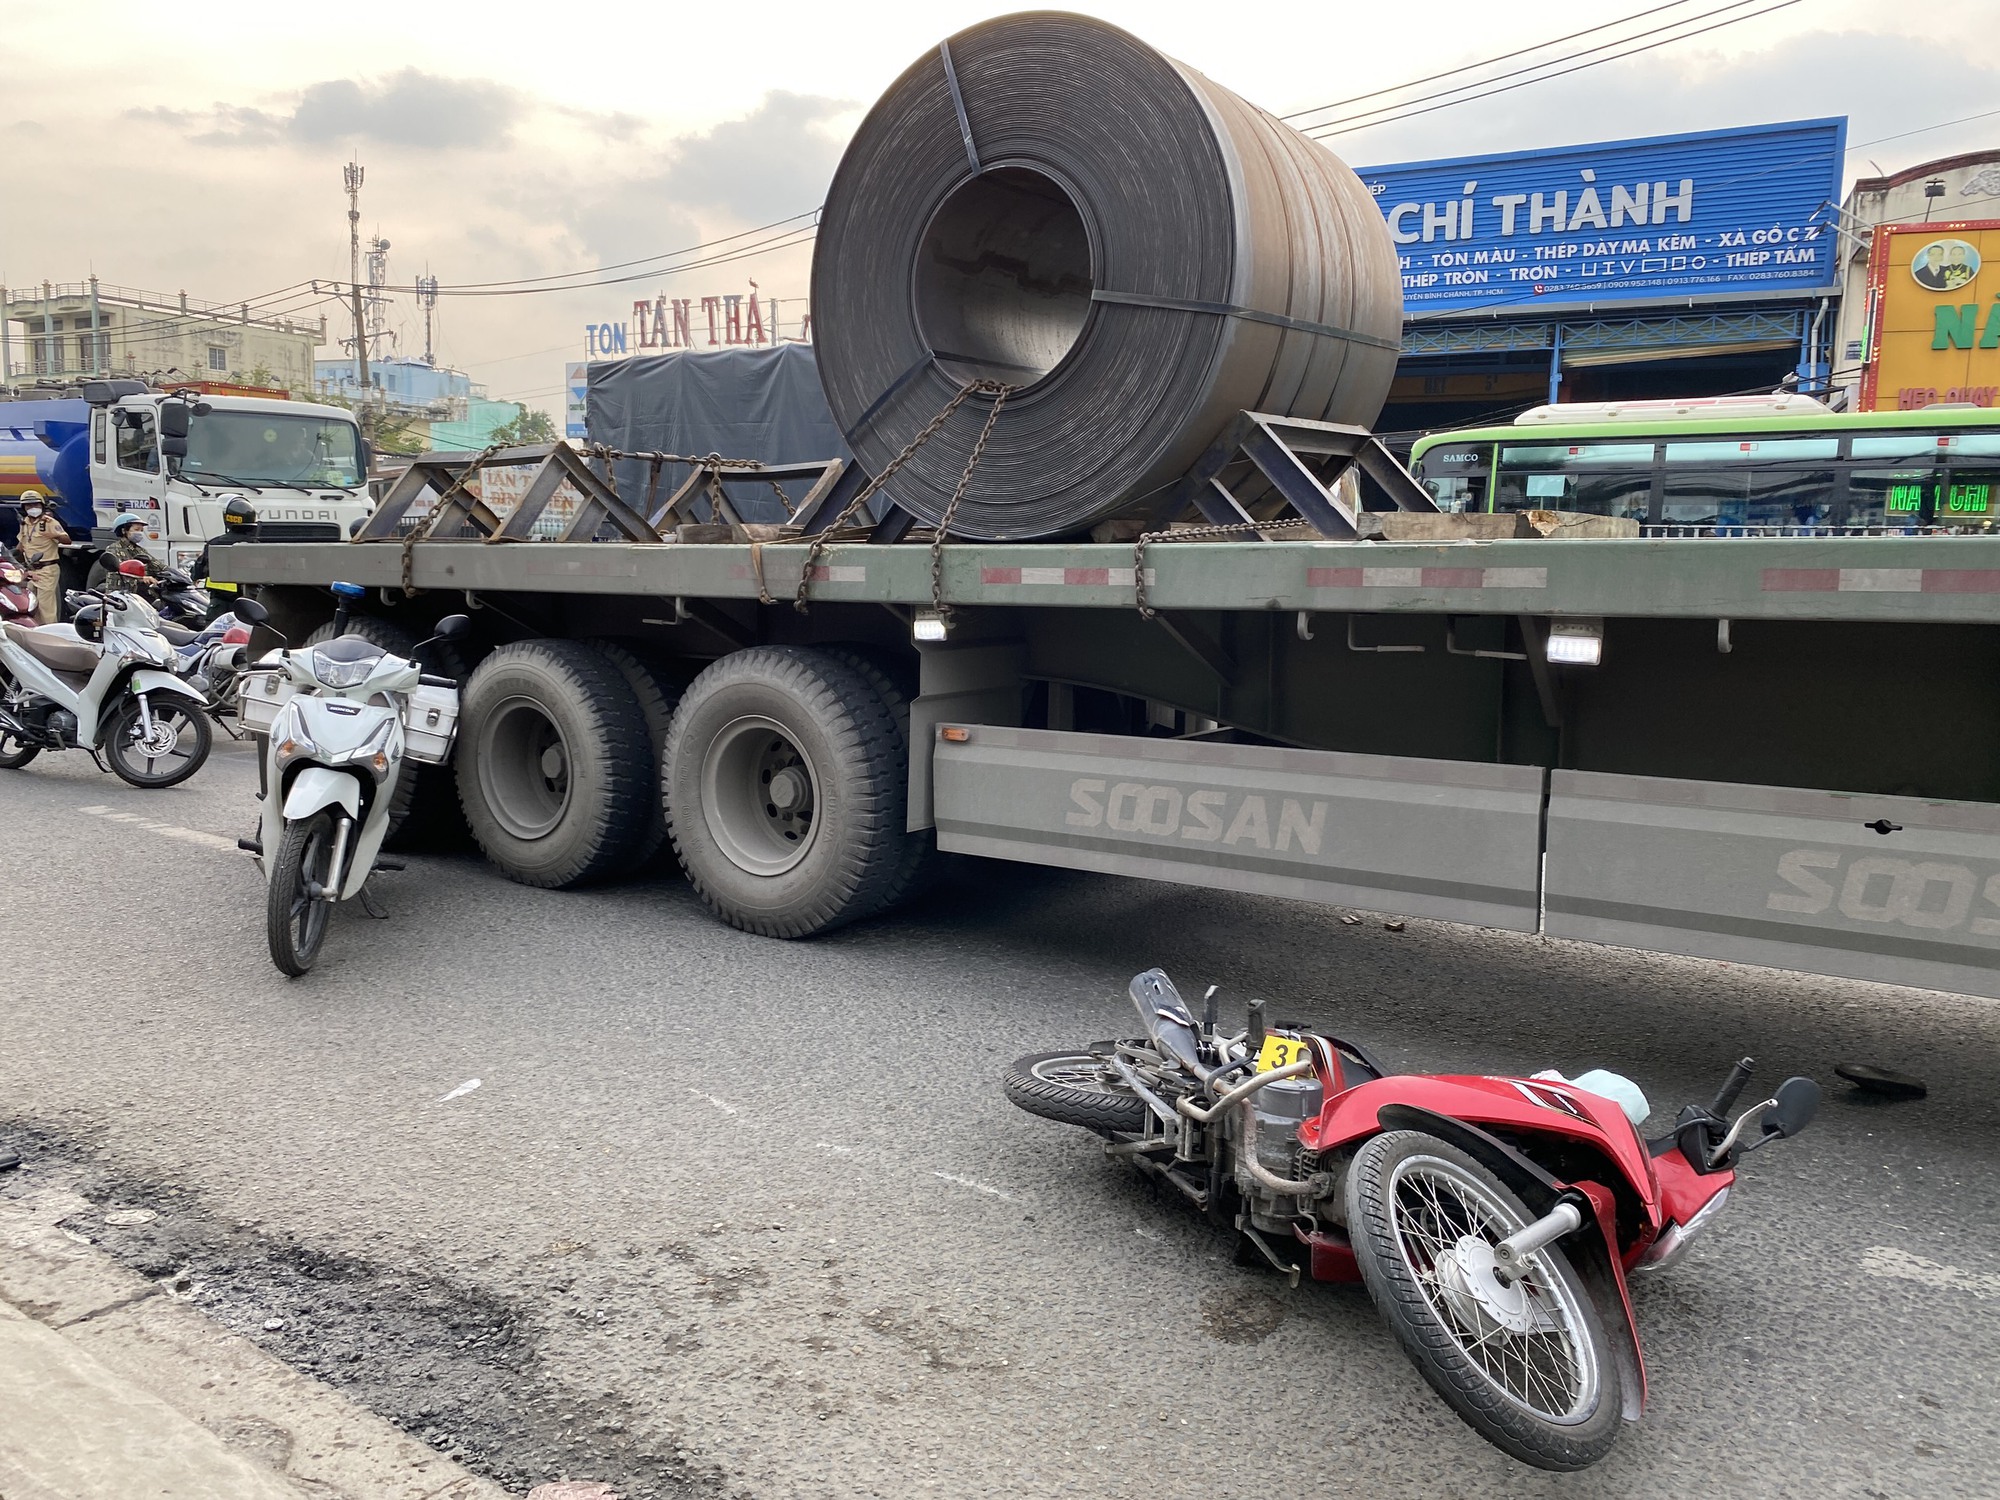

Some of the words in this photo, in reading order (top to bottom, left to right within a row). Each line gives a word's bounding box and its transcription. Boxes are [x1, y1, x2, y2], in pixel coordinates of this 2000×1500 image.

[1387, 181, 1478, 244] CHÍ
[1492, 169, 1693, 236] THÀNH
[1403, 271, 1439, 288] THÉP
[1444, 267, 1488, 285] TRÒN
[1509, 265, 1558, 281] TRƠN
[1726, 248, 1770, 268] THÉP
[1774, 245, 1815, 264] TẤM
[1432, 250, 1468, 267] TÔN
[1473, 247, 1515, 264] MÀU
[1534, 242, 1577, 260] THÉP
[1657, 233, 1696, 252] KẼM
[1718, 228, 1746, 247] XÀ
[1443, 454, 1478, 462] SAMCO
[256, 509, 338, 520] YUNDAI
[1065, 778, 1328, 855] SOOSAN
[1271, 1044, 1289, 1069] 3
